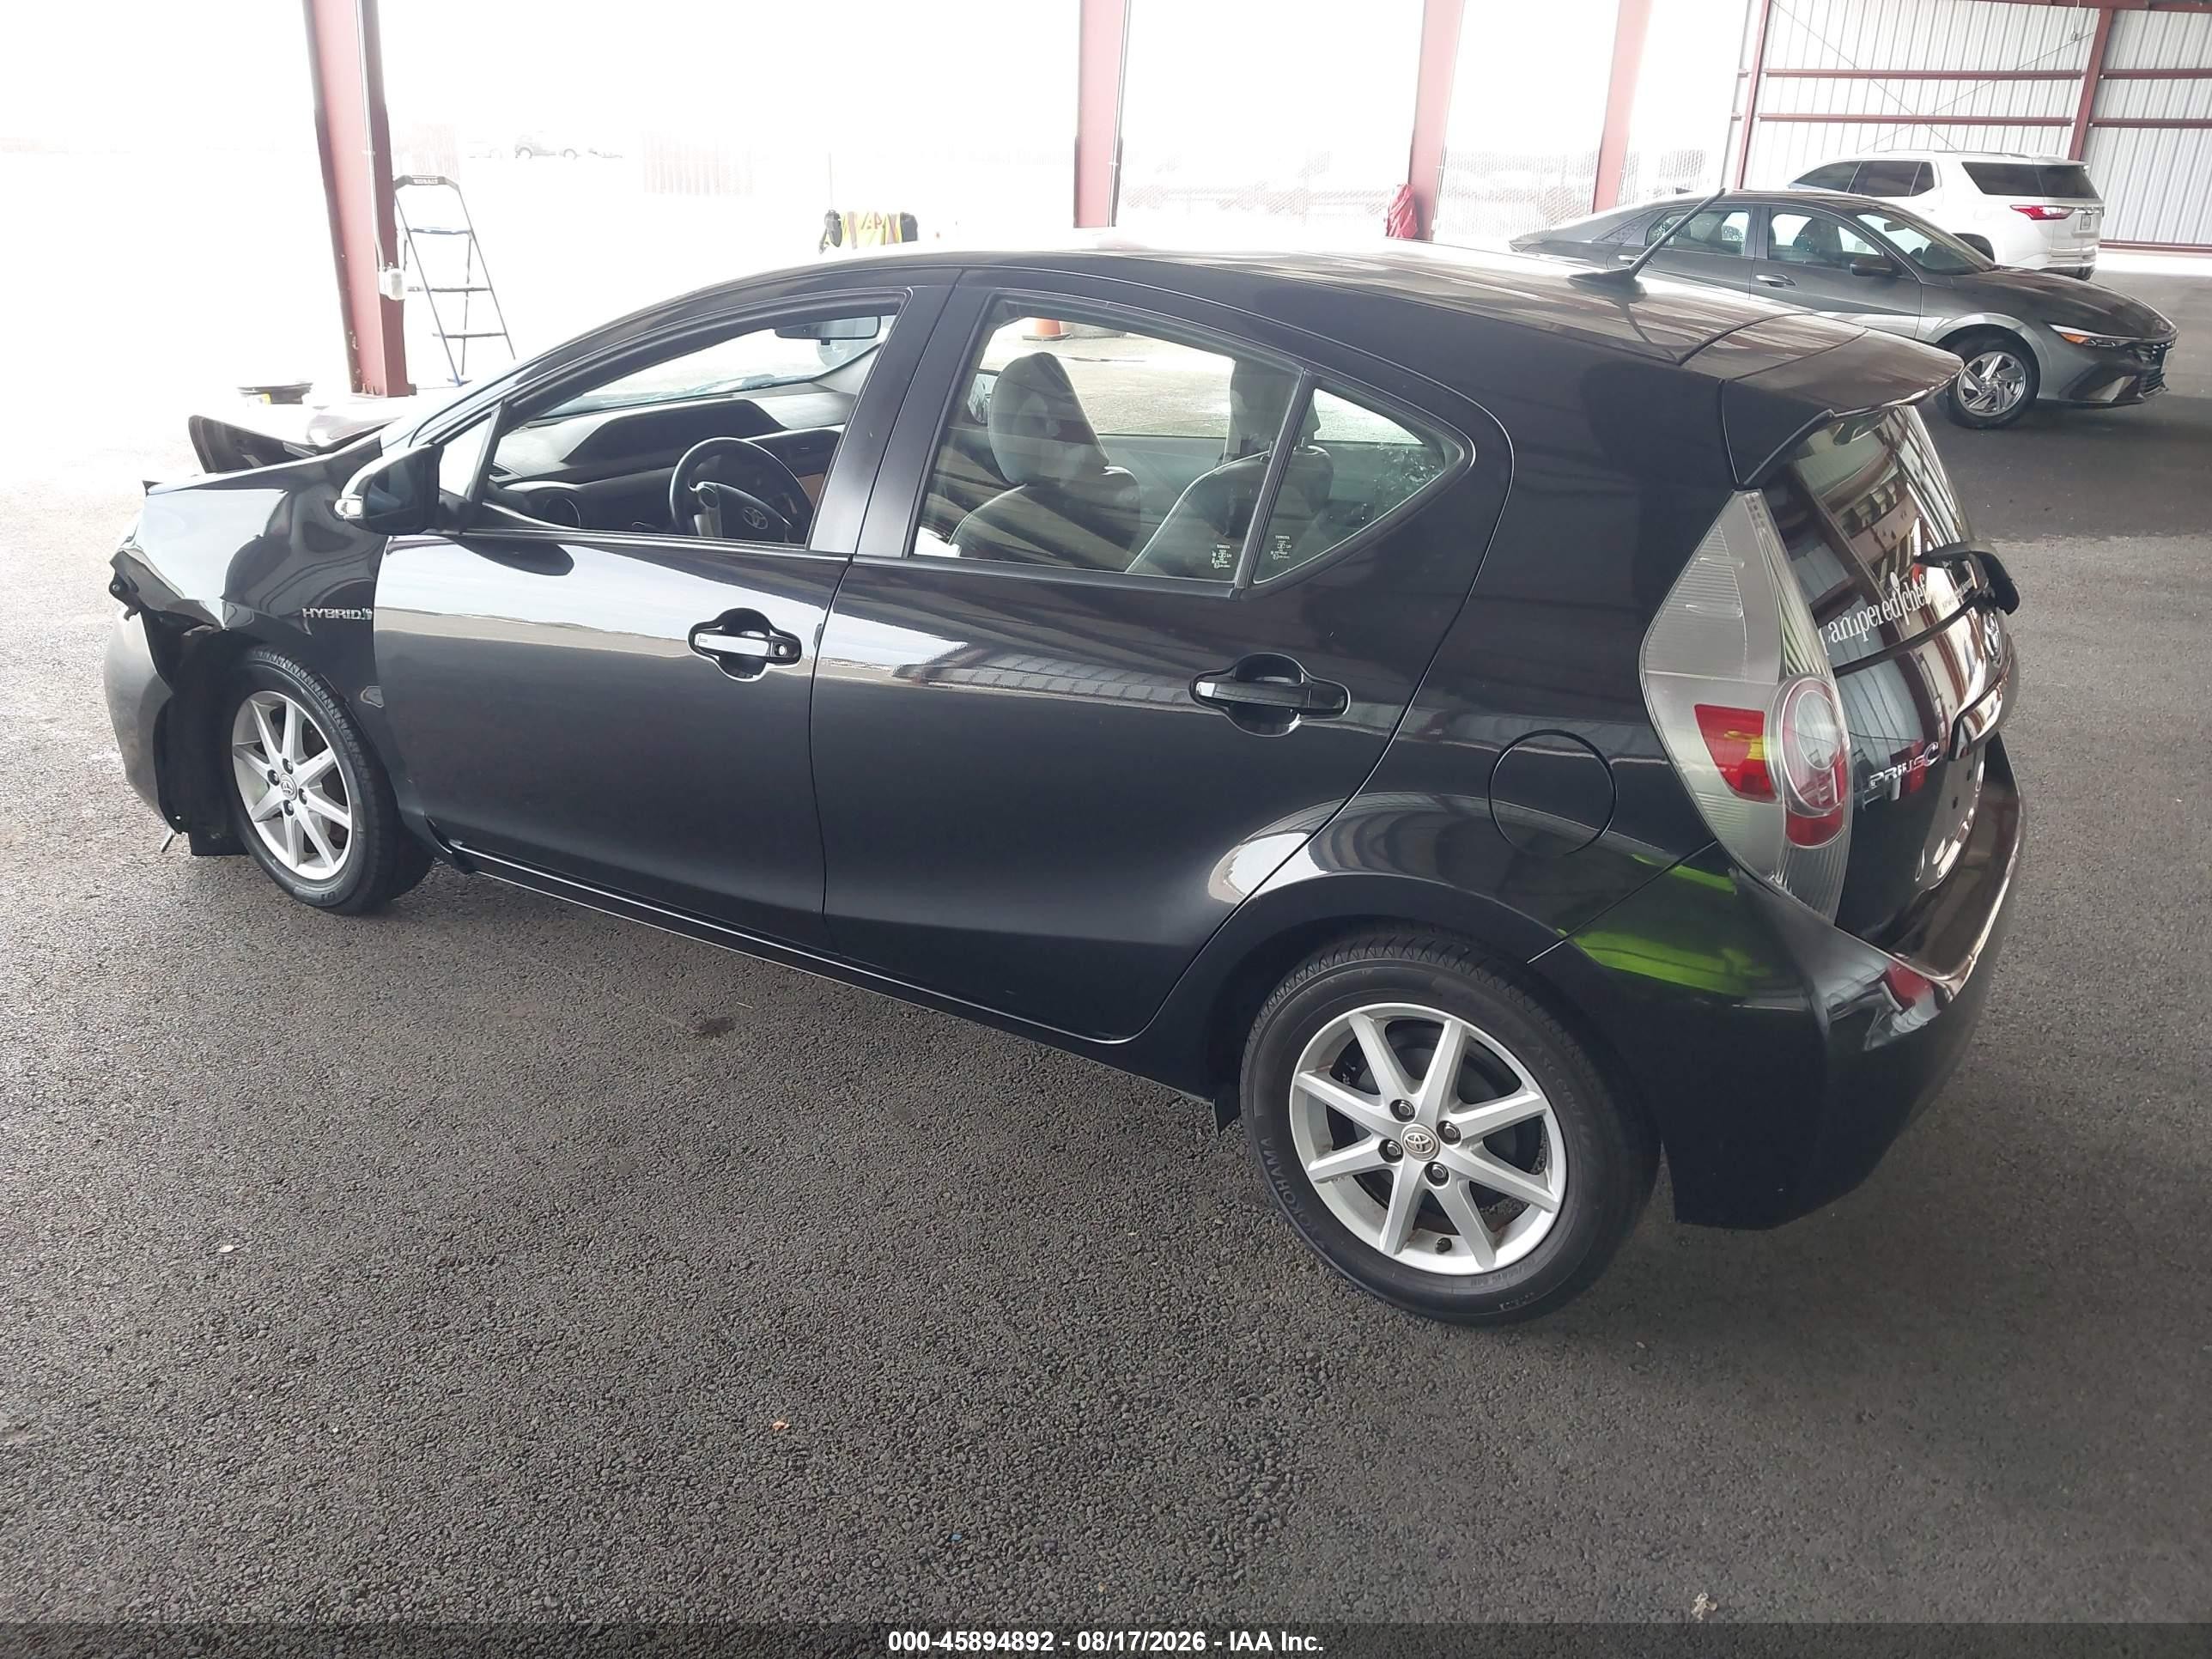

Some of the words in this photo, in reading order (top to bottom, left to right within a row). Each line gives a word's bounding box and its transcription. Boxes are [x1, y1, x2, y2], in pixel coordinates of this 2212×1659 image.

[1901, 573, 1931, 612] chef
[302, 607, 362, 620] HYBRID
[1868, 754, 1924, 790] PRIUS
[1259, 1136, 1321, 1237] YOKOHAMA
